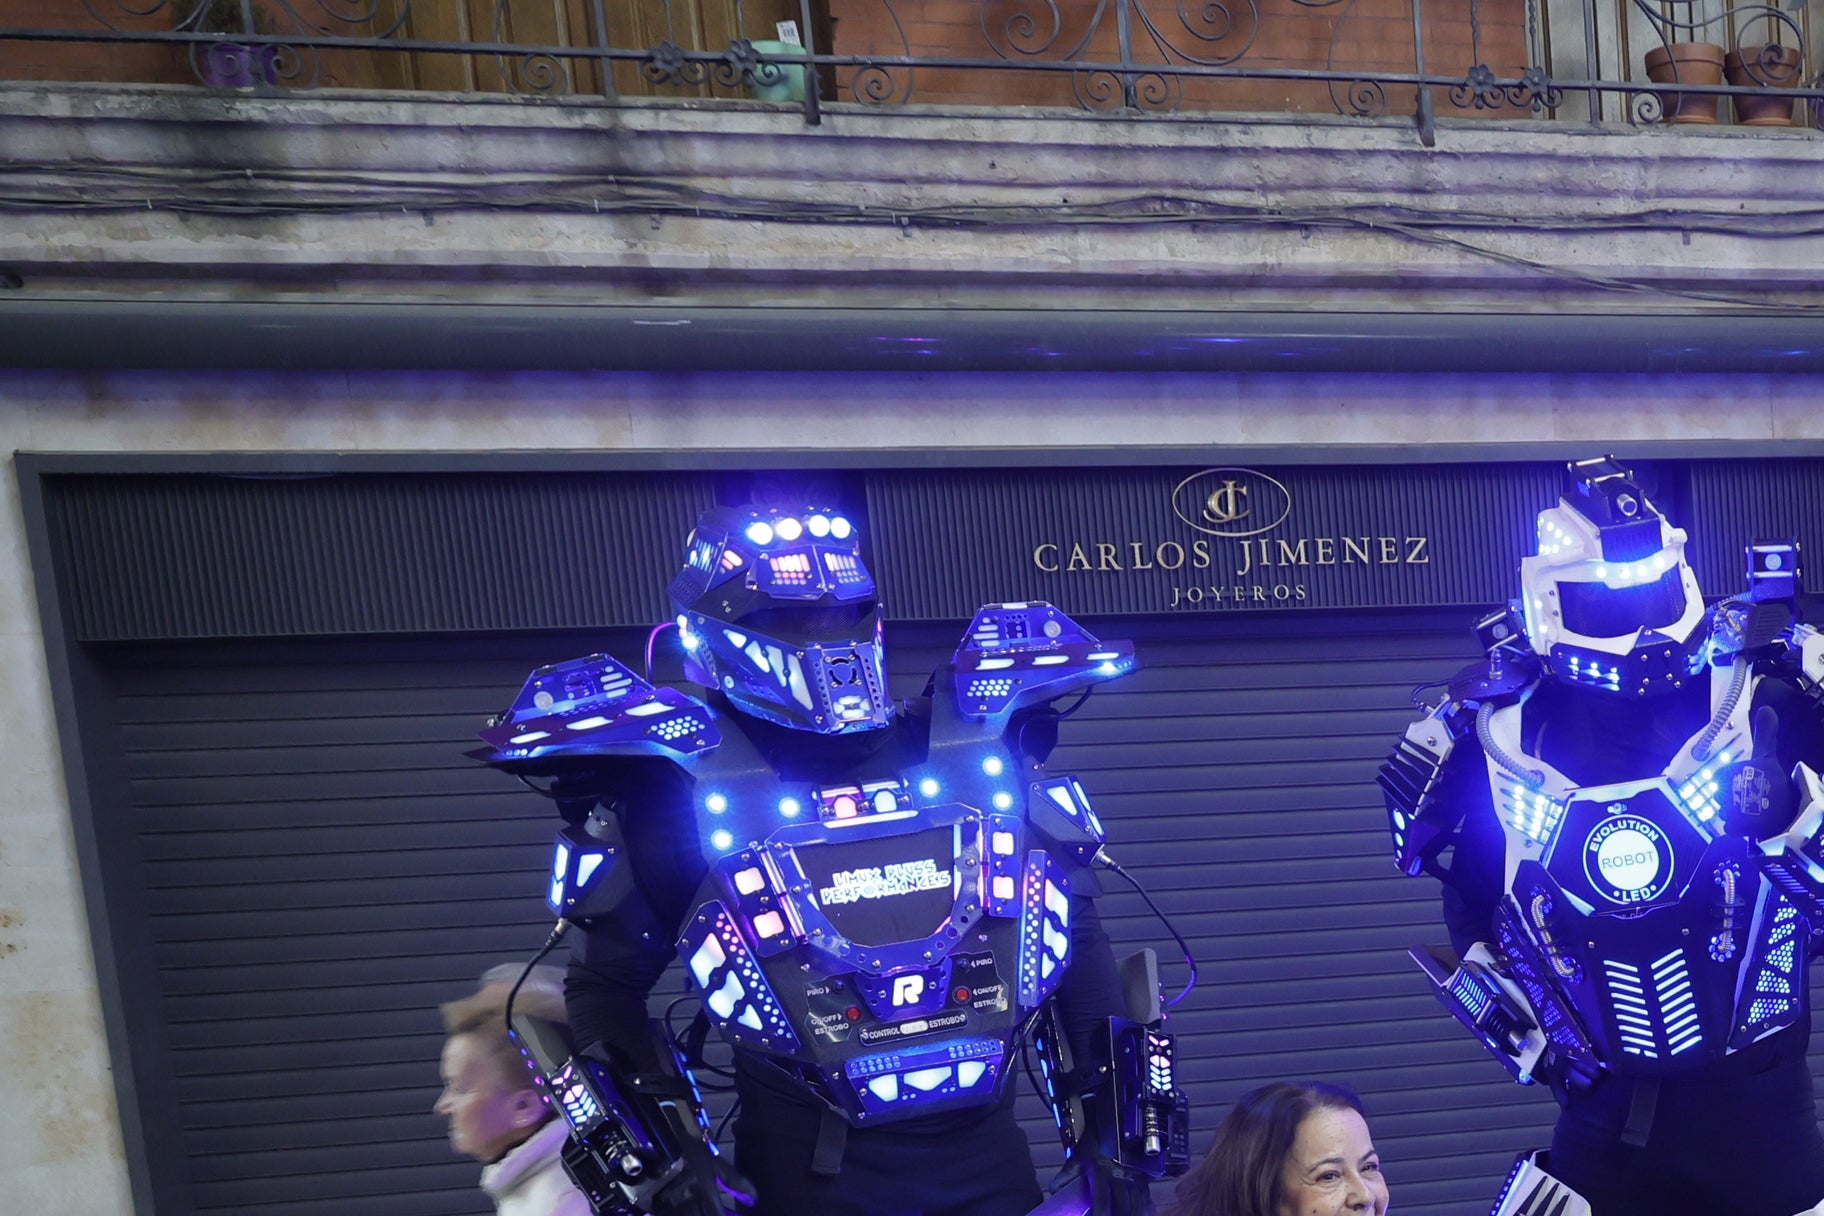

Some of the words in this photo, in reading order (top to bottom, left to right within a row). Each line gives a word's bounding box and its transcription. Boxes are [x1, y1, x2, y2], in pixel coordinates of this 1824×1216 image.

[1033, 540, 1211, 572] CARLOS
[1237, 536, 1430, 575] JIMENEZ
[1171, 584, 1306, 607] JOYEROS
[1589, 819, 1659, 852] EVOLUTION
[1601, 851, 1653, 869] ROBOT
[1622, 887, 1651, 902] LED
[975, 957, 993, 967] PIRO
[806, 987, 824, 997] PIRO
[892, 974, 924, 1006] R
[814, 1022, 849, 1035] ESTROBO
[869, 1025, 900, 1040] CONTROL
[928, 1015, 961, 1029] ESTROBO
